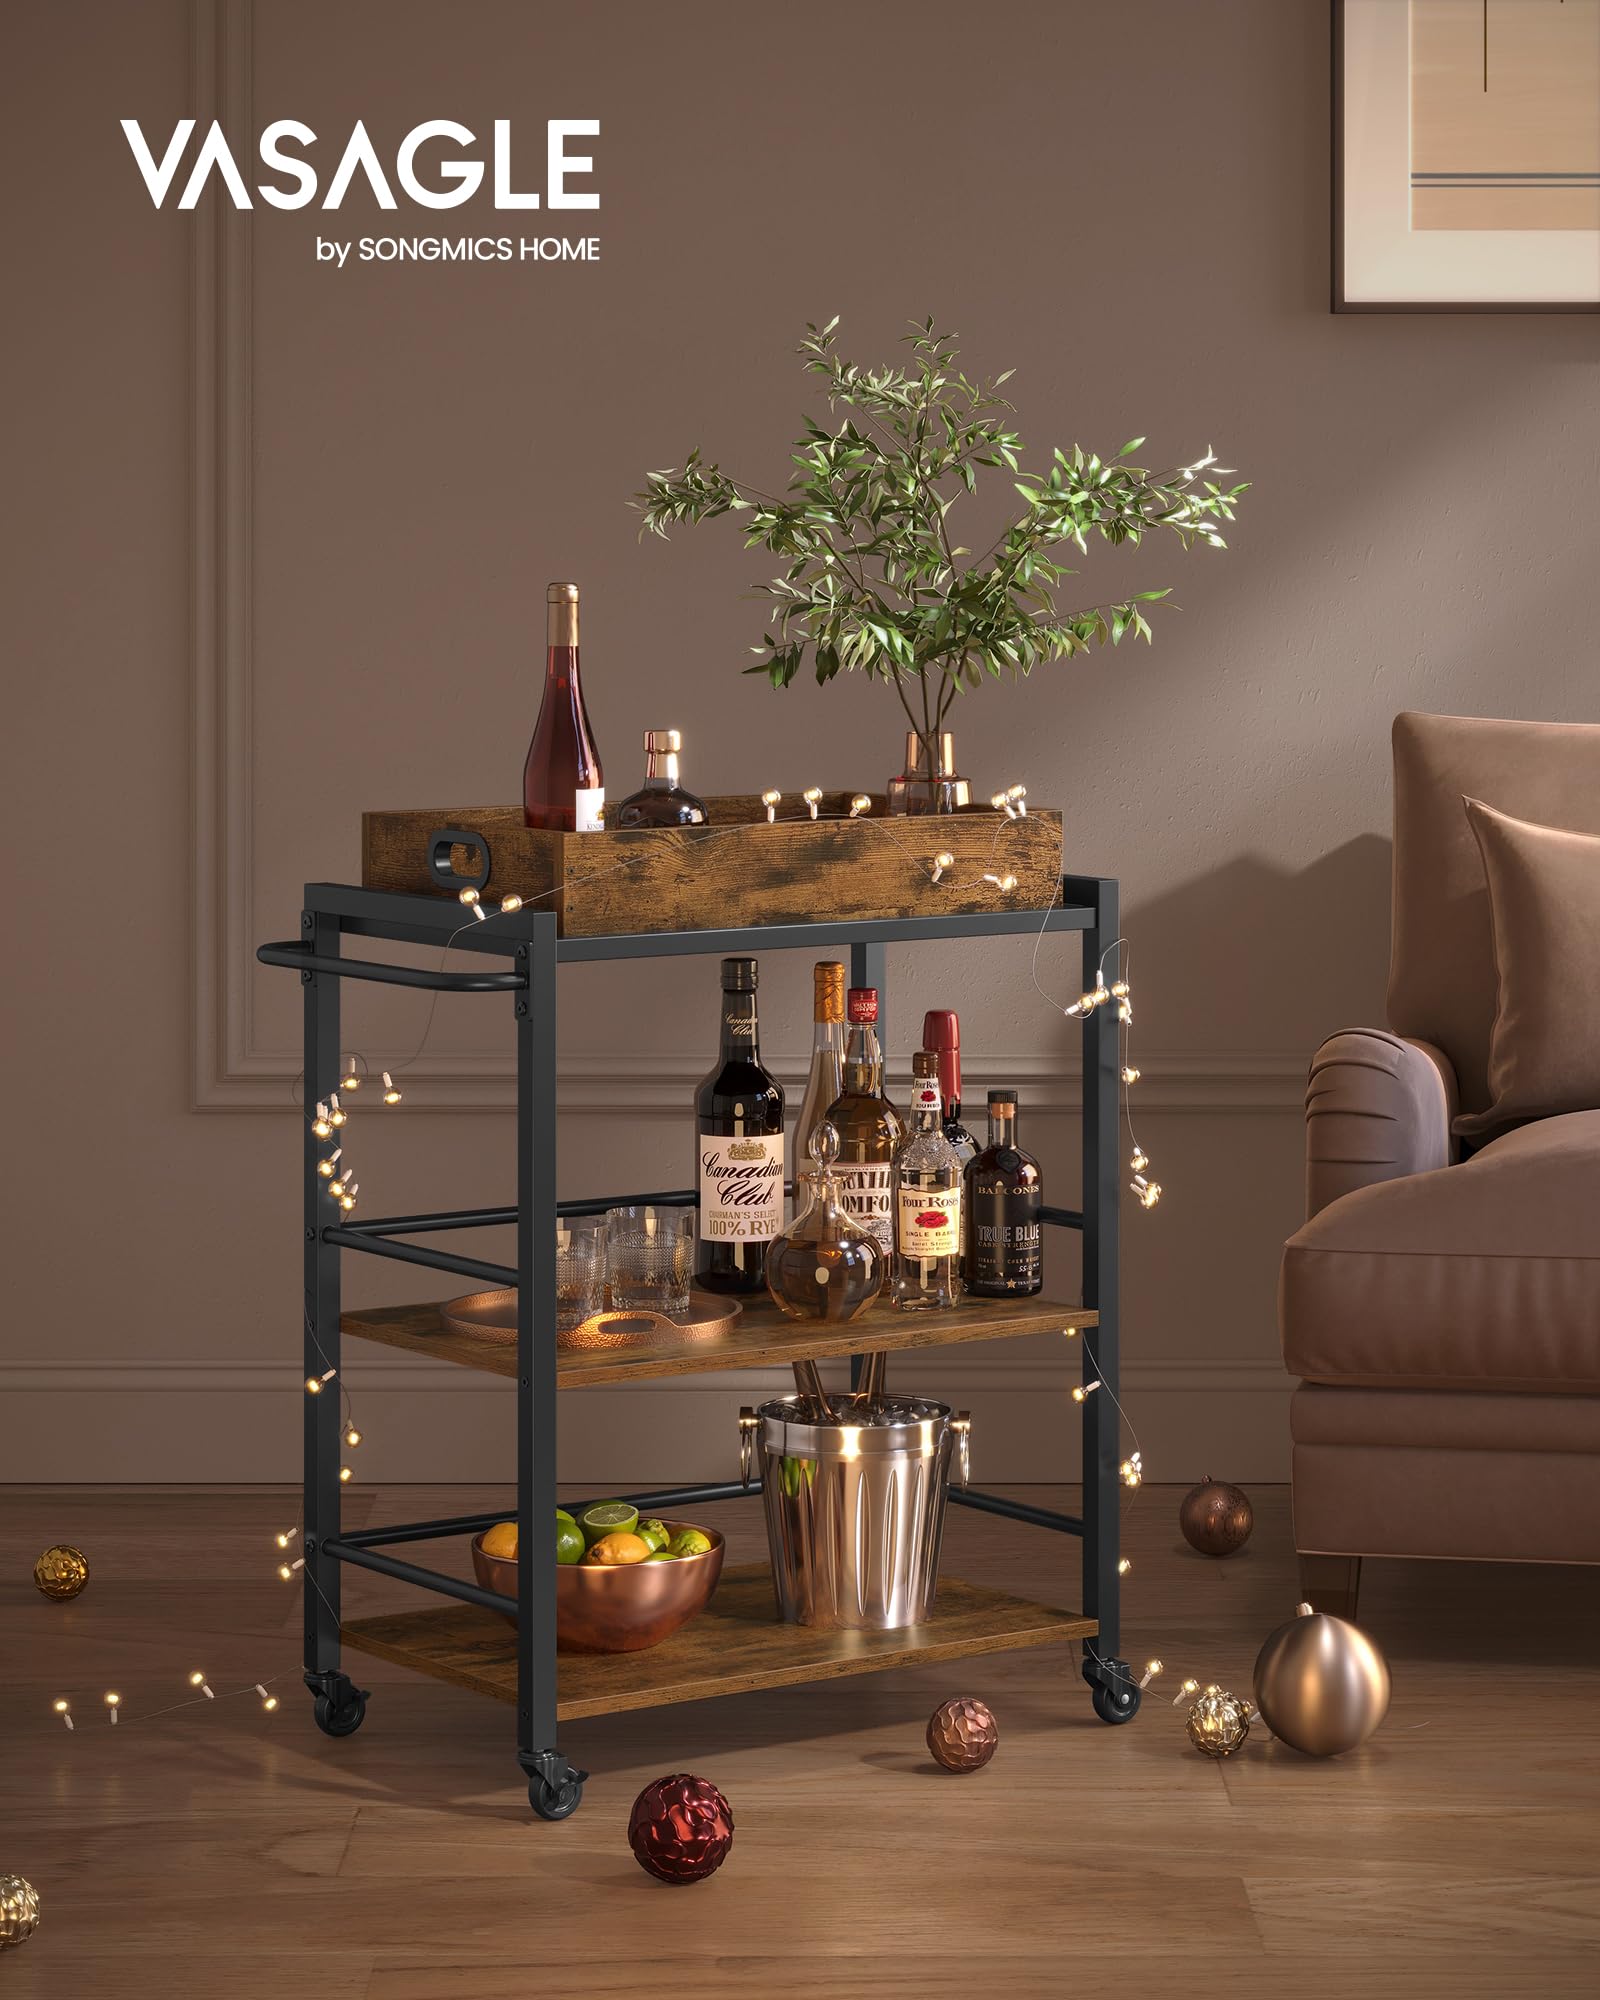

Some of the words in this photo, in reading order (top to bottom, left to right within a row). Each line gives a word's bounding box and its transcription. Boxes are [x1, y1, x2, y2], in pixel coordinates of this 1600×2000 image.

[702, 1151, 784, 1179] Canadian
[717, 1180, 775, 1206] Club
[902, 1196, 926, 1208] Four
[709, 1220, 746, 1236] 100%
[749, 1219, 775, 1236] RYE
[978, 1225, 1012, 1242] TRUE
[1015, 1224, 1040, 1242] BLUE
